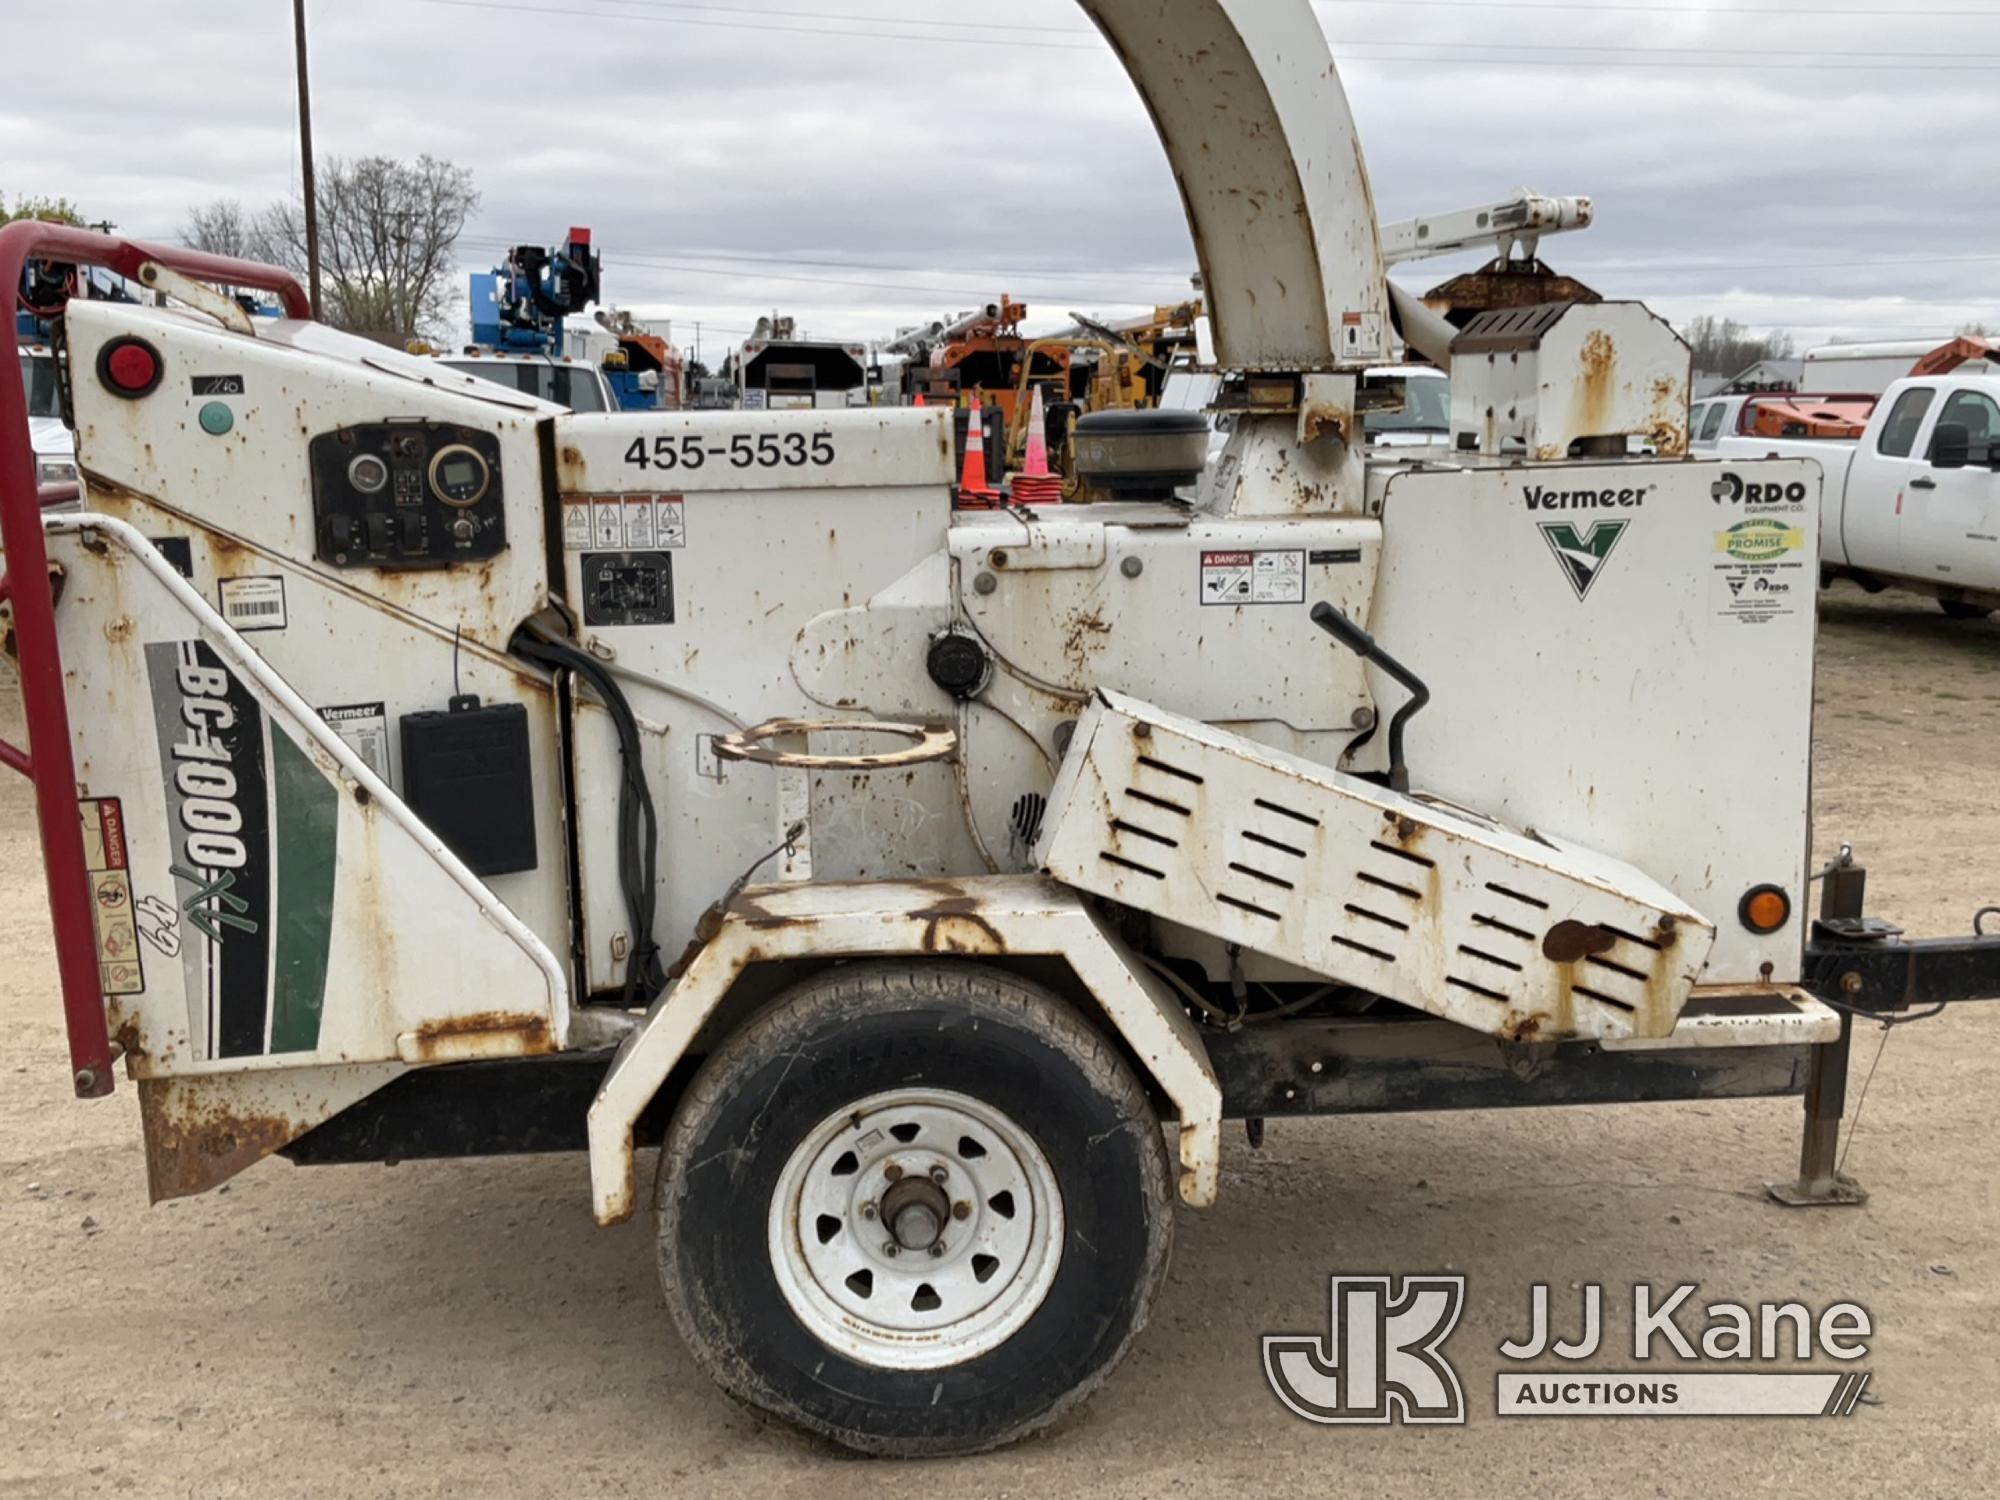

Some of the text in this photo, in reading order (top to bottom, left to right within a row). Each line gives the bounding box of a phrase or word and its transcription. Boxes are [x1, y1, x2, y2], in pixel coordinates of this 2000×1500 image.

[624, 432, 835, 470] 455-5535
[1523, 485, 1647, 510] Vermeer
[1745, 505, 1789, 514] EQUIPMENT
[1727, 537, 1782, 549] PROMISE
[1214, 552, 1250, 565] DANGER
[322, 707, 377, 720] Vermeer
[106, 817, 122, 867] DANGER
